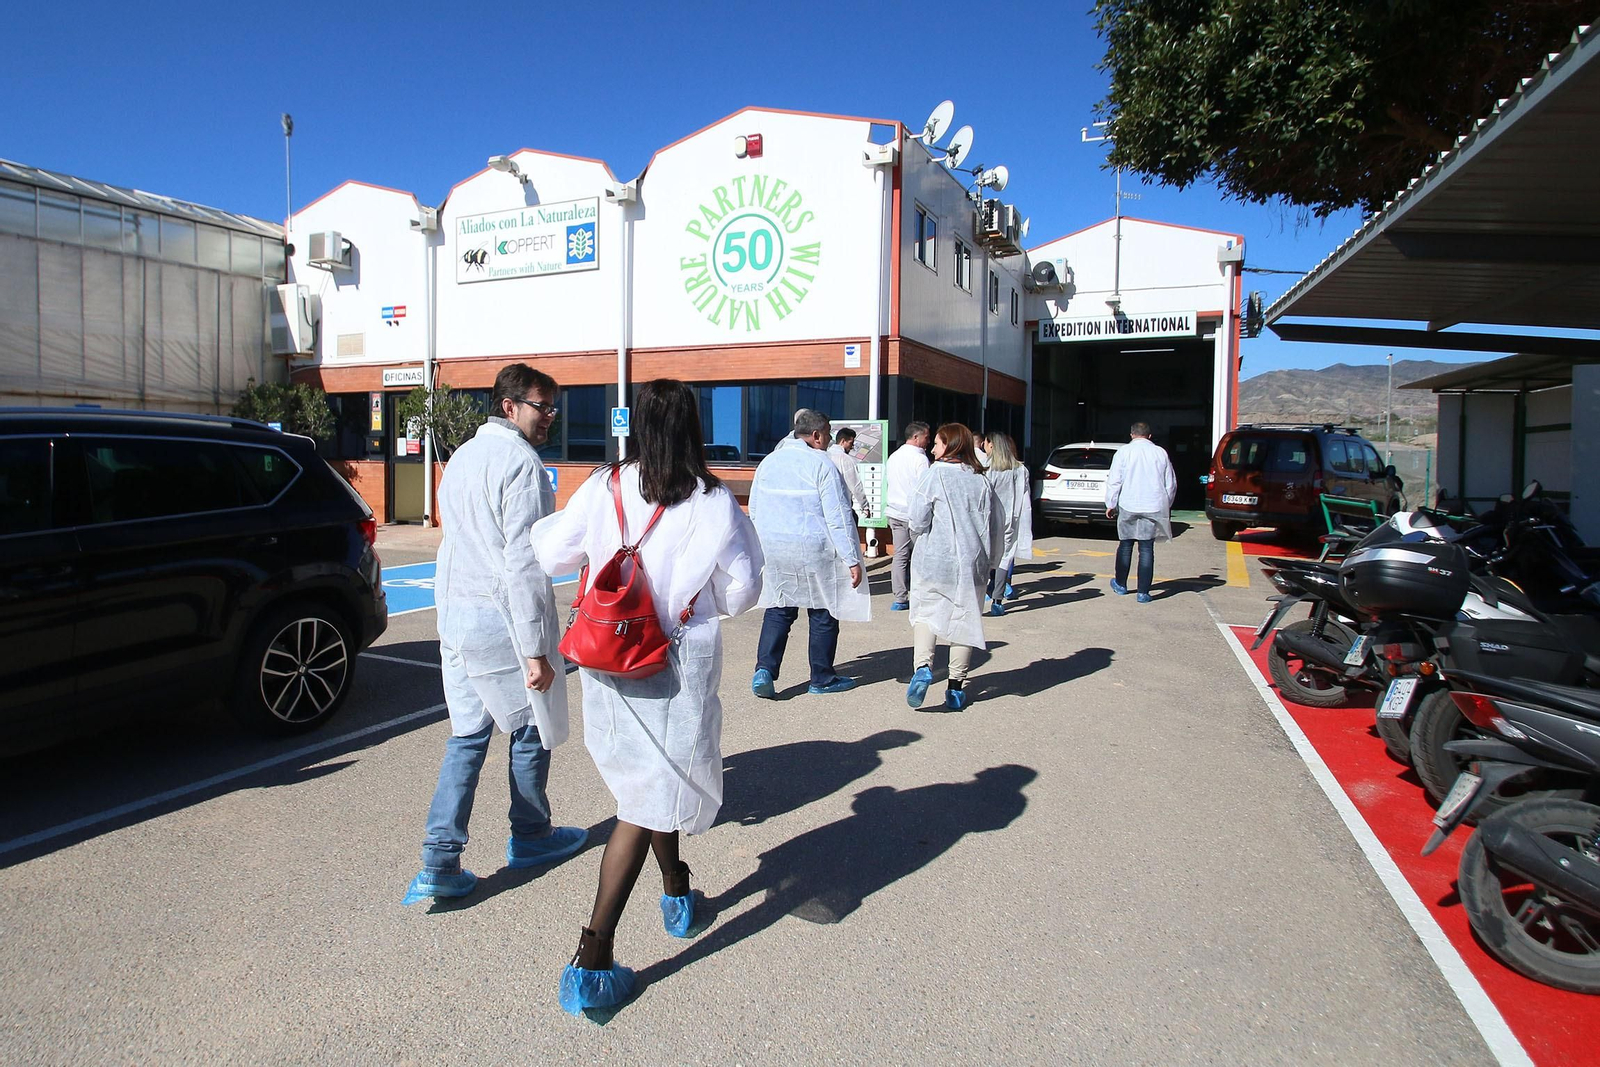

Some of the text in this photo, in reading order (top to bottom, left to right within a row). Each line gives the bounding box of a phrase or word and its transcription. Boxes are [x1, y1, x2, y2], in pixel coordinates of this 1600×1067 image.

[459, 203, 596, 235] Aliados con La Naturaleza
[680, 174, 821, 332] PARTNERS WITH NATURE
[722, 228, 774, 273] 50
[488, 266, 518, 277] Partners
[519, 263, 535, 274] with
[536, 261, 562, 272] Nature
[731, 282, 764, 294] YEARS
[1043, 316, 1191, 338] EXPEDITION INTERNATIONAL
[384, 371, 423, 382] OFICINAS
